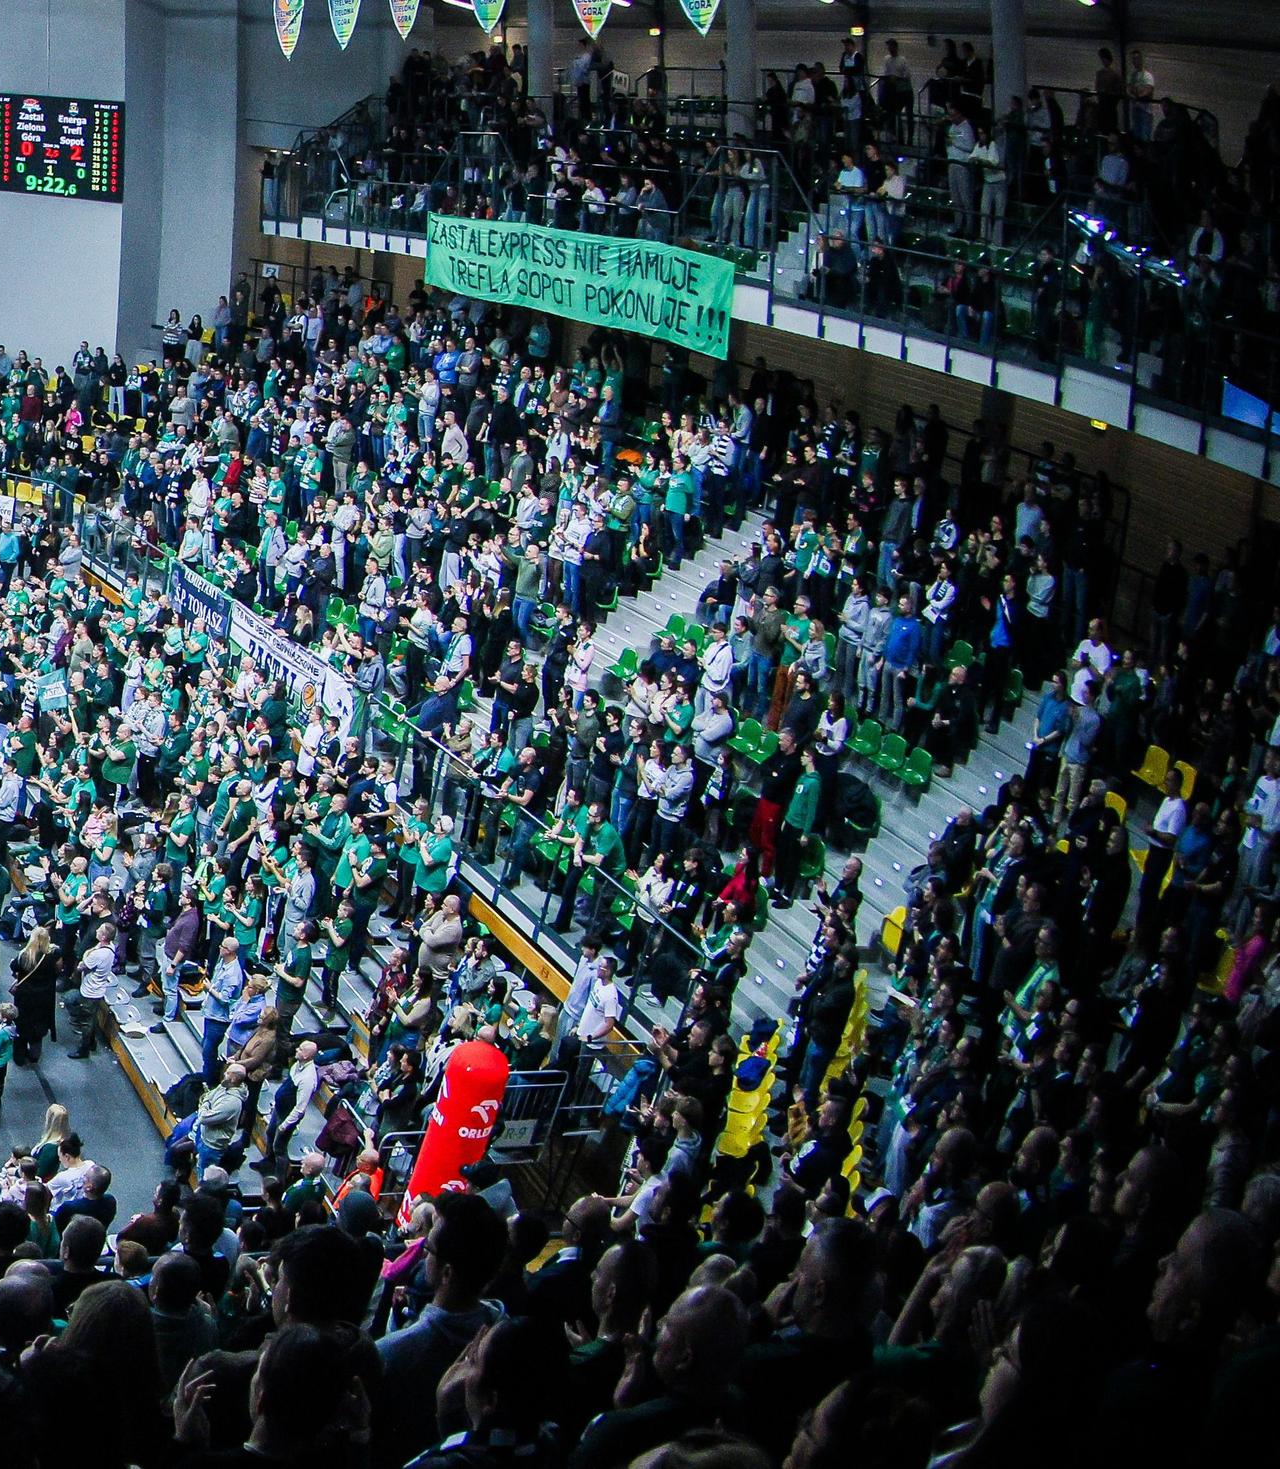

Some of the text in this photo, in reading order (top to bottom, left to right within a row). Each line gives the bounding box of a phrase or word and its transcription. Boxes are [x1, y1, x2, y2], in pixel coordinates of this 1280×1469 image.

[19, 112, 44, 121] Zastal
[58, 115, 87, 125] Energa
[16, 122, 46, 132] Zielona
[62, 126, 82, 135] Trefl
[21, 132, 41, 142] Góra
[60, 136, 85, 147] Sopot
[21, 142, 33, 156] 0
[70, 146, 82, 160] 2
[16, 163, 25, 173] 0
[47, 165, 54, 176] 1
[77, 168, 85, 179] 0
[431, 217, 702, 297] ZASTALEXPRESS NIE HAMUJE
[448, 255, 727, 345] TREFLA SOPOT POKONUJE !!!
[188, 595, 223, 633] TOMASZ
